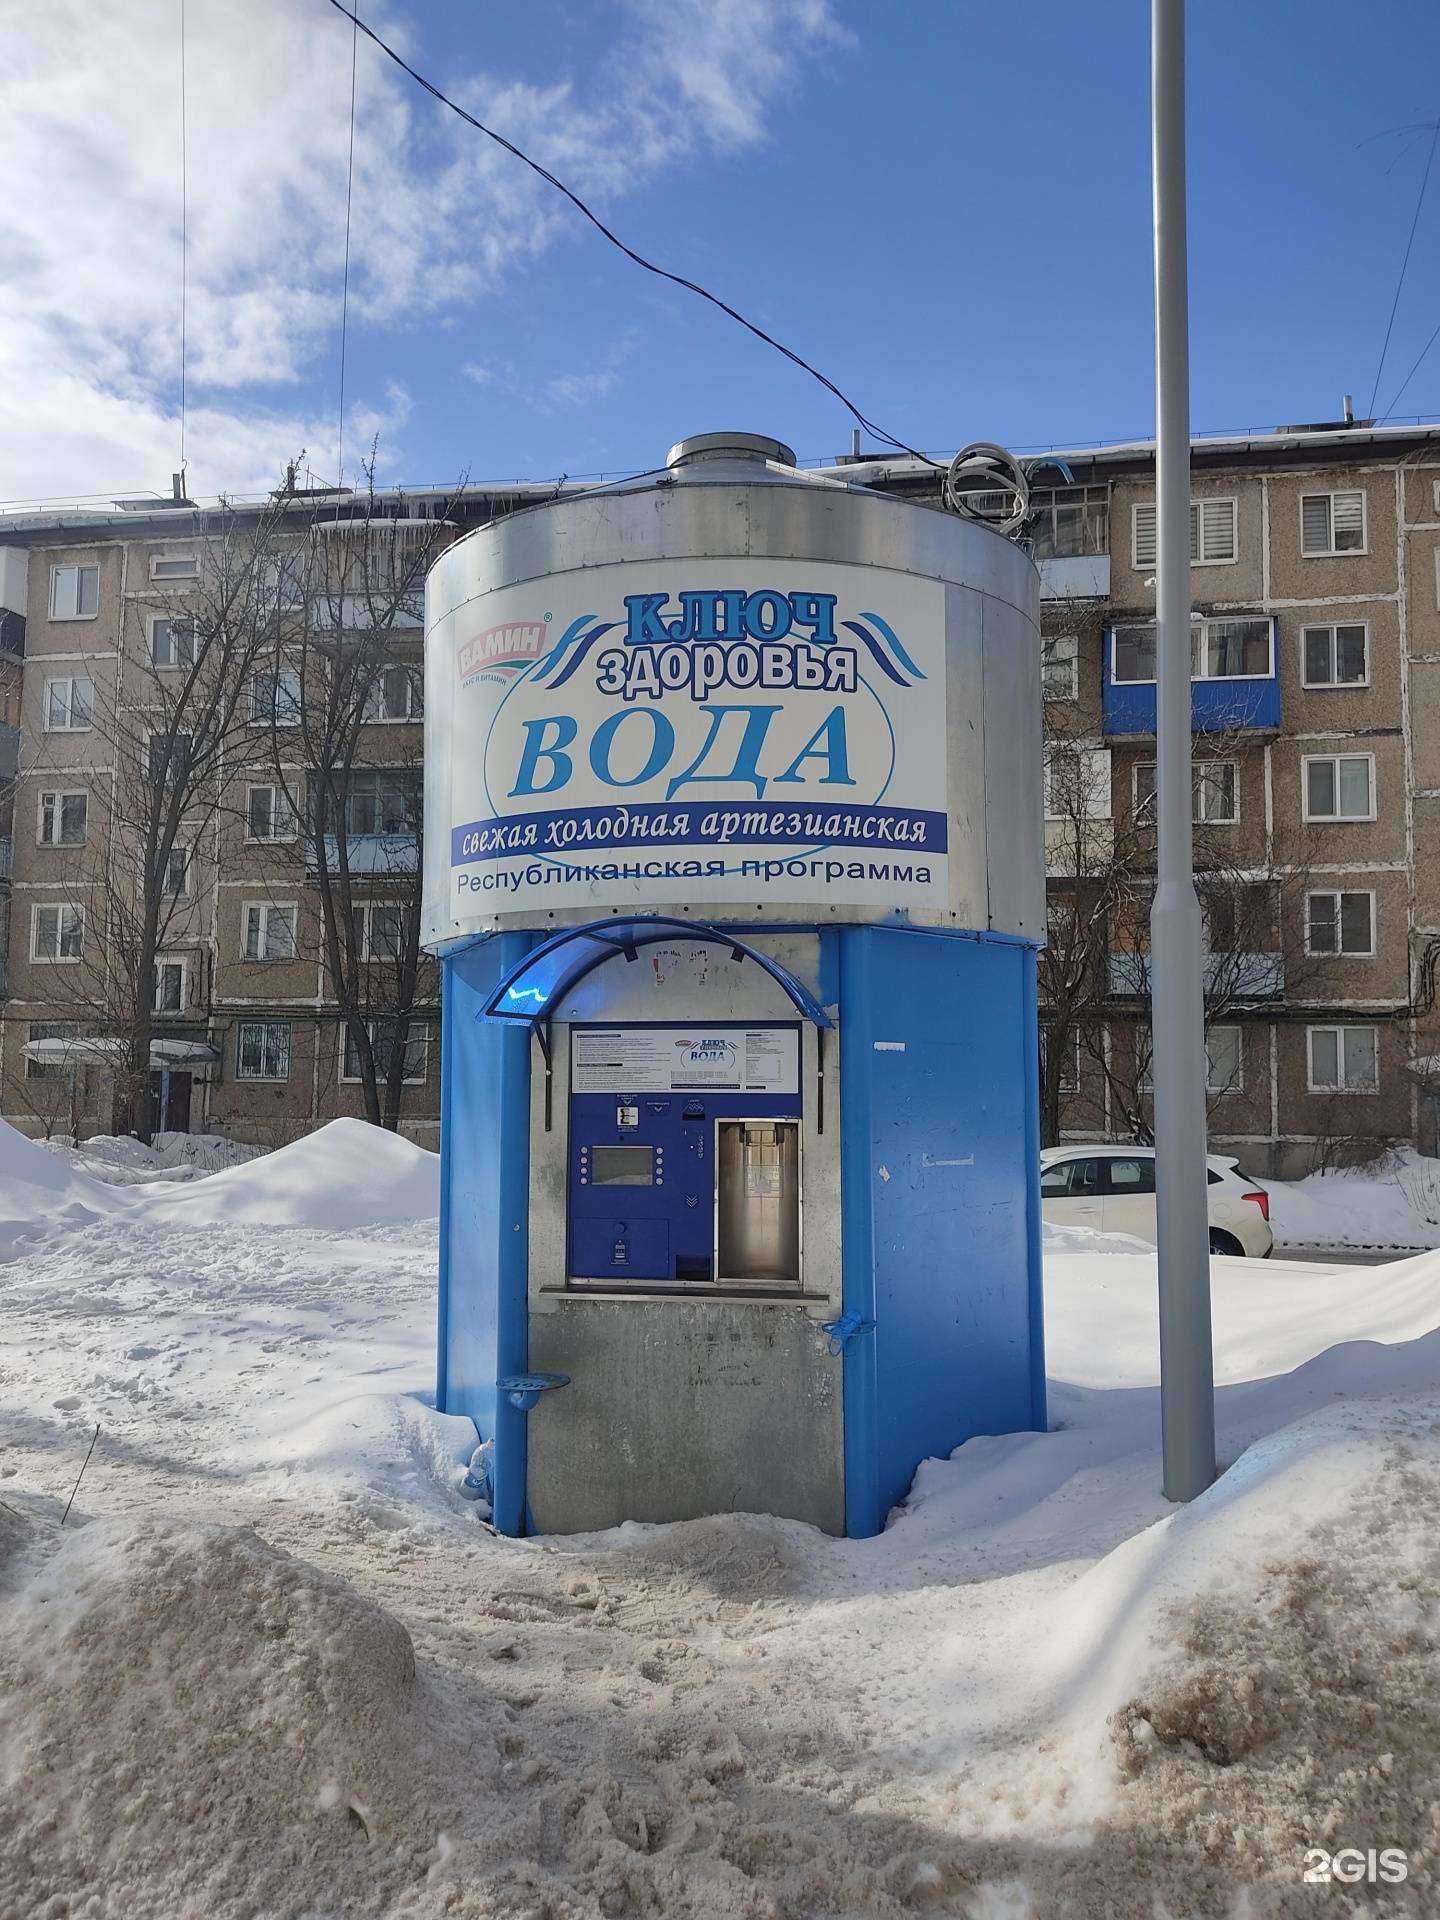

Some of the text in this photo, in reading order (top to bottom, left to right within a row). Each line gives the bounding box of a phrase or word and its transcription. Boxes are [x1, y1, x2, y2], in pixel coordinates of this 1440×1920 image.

[624, 590, 837, 645] КЛЮЧ
[460, 627, 540, 672] ВАМИН
[596, 642, 858, 701] ЗДОРОВЬЯ
[507, 704, 857, 801] ВОДА
[462, 807, 927, 856] свежая холодная артезианская
[457, 859, 931, 894] Республиканская программа
